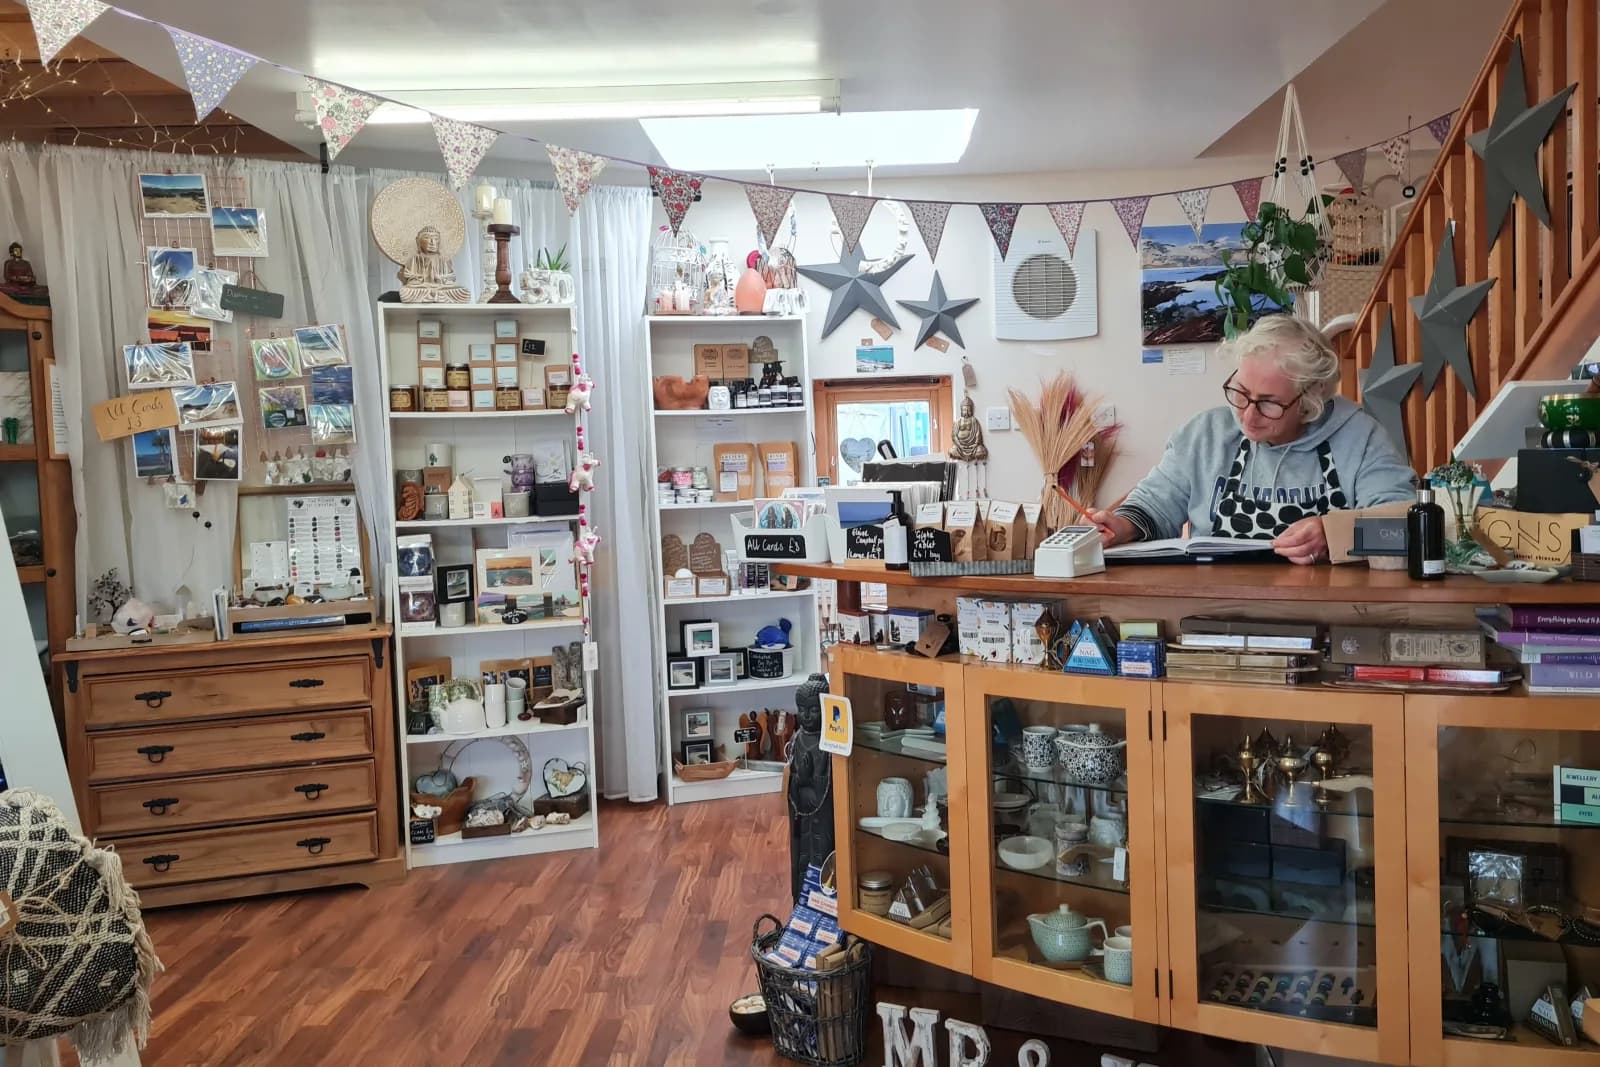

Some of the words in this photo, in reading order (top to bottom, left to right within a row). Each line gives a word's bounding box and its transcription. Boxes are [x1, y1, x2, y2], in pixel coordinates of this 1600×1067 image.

[105, 402, 126, 421] All
[131, 396, 164, 415] Cards
[1487, 519, 1562, 552] GNS
[747, 538, 760, 551] All
[762, 539, 784, 552] Cards
[913, 539, 936, 549] Tablet
[1537, 615, 1566, 625] Everything
[1080, 648, 1096, 656] NAG
